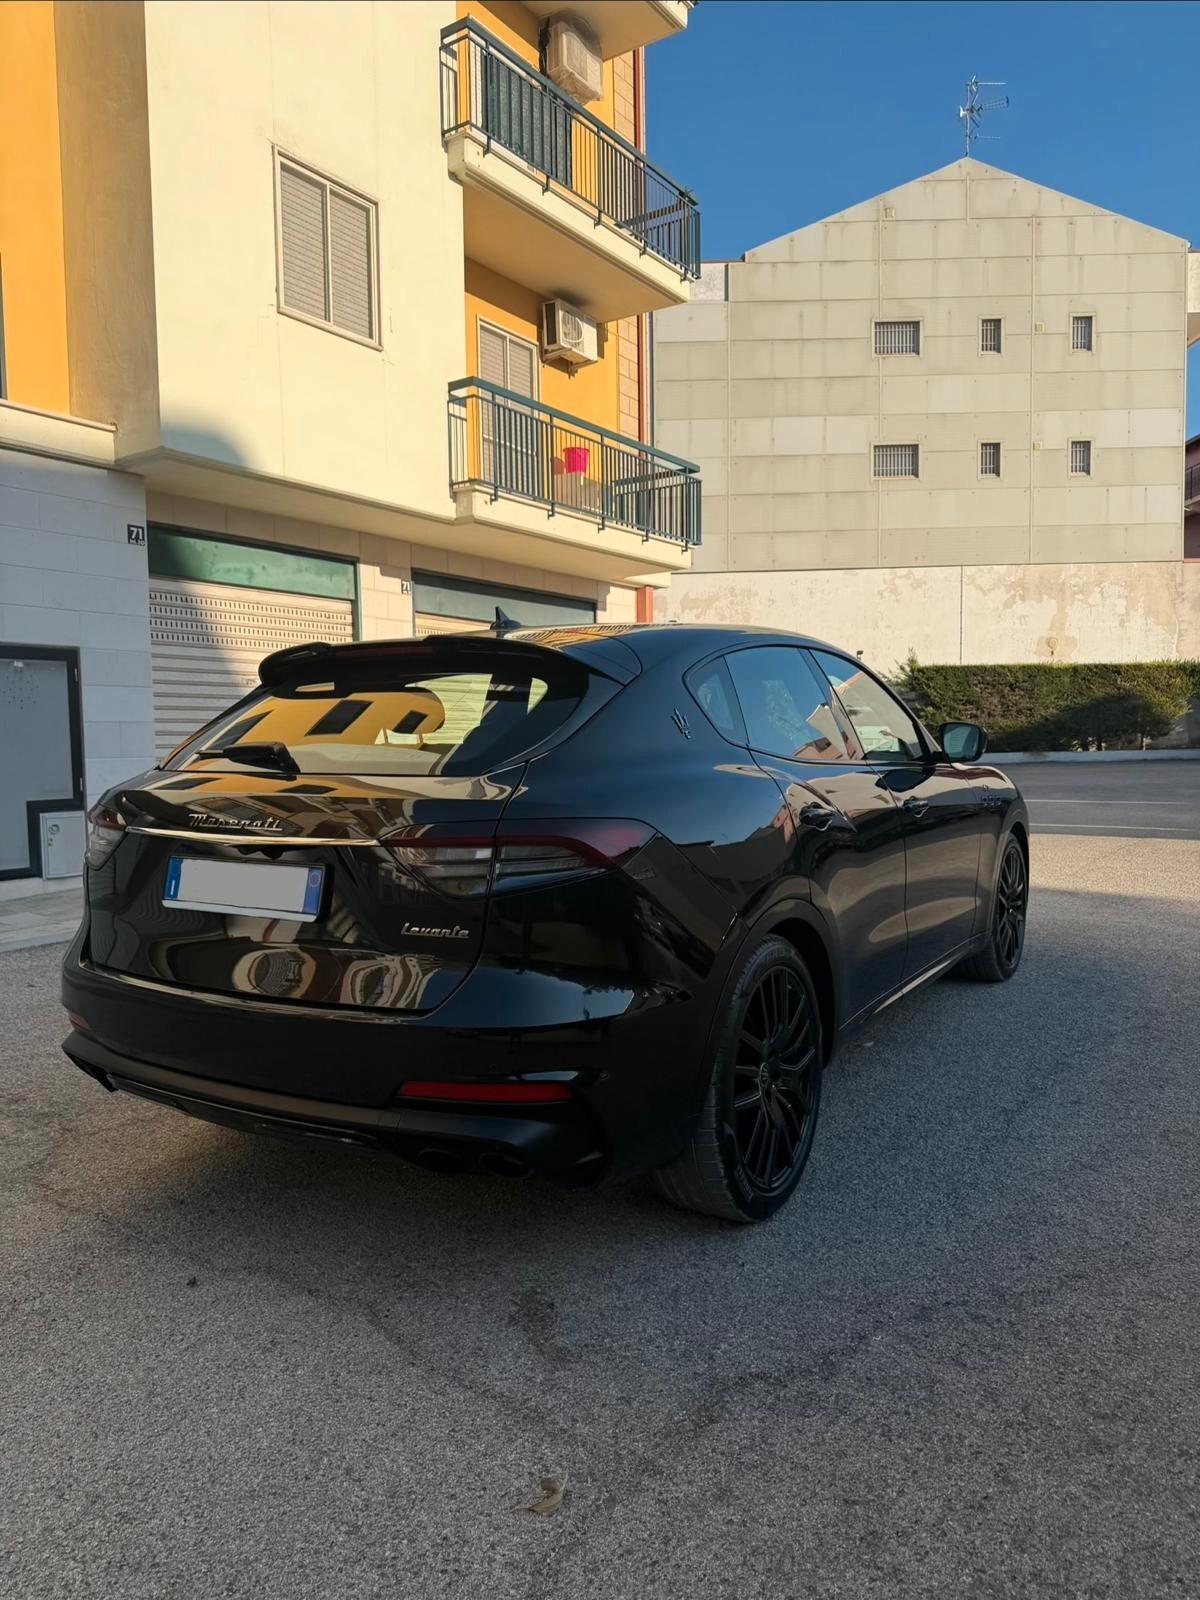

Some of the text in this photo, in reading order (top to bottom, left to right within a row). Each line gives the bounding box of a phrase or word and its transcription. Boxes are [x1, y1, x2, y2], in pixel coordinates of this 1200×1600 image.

[129, 526, 143, 540] 71
[188, 813, 284, 832] Maserati
[400, 922, 470, 939] Levante
